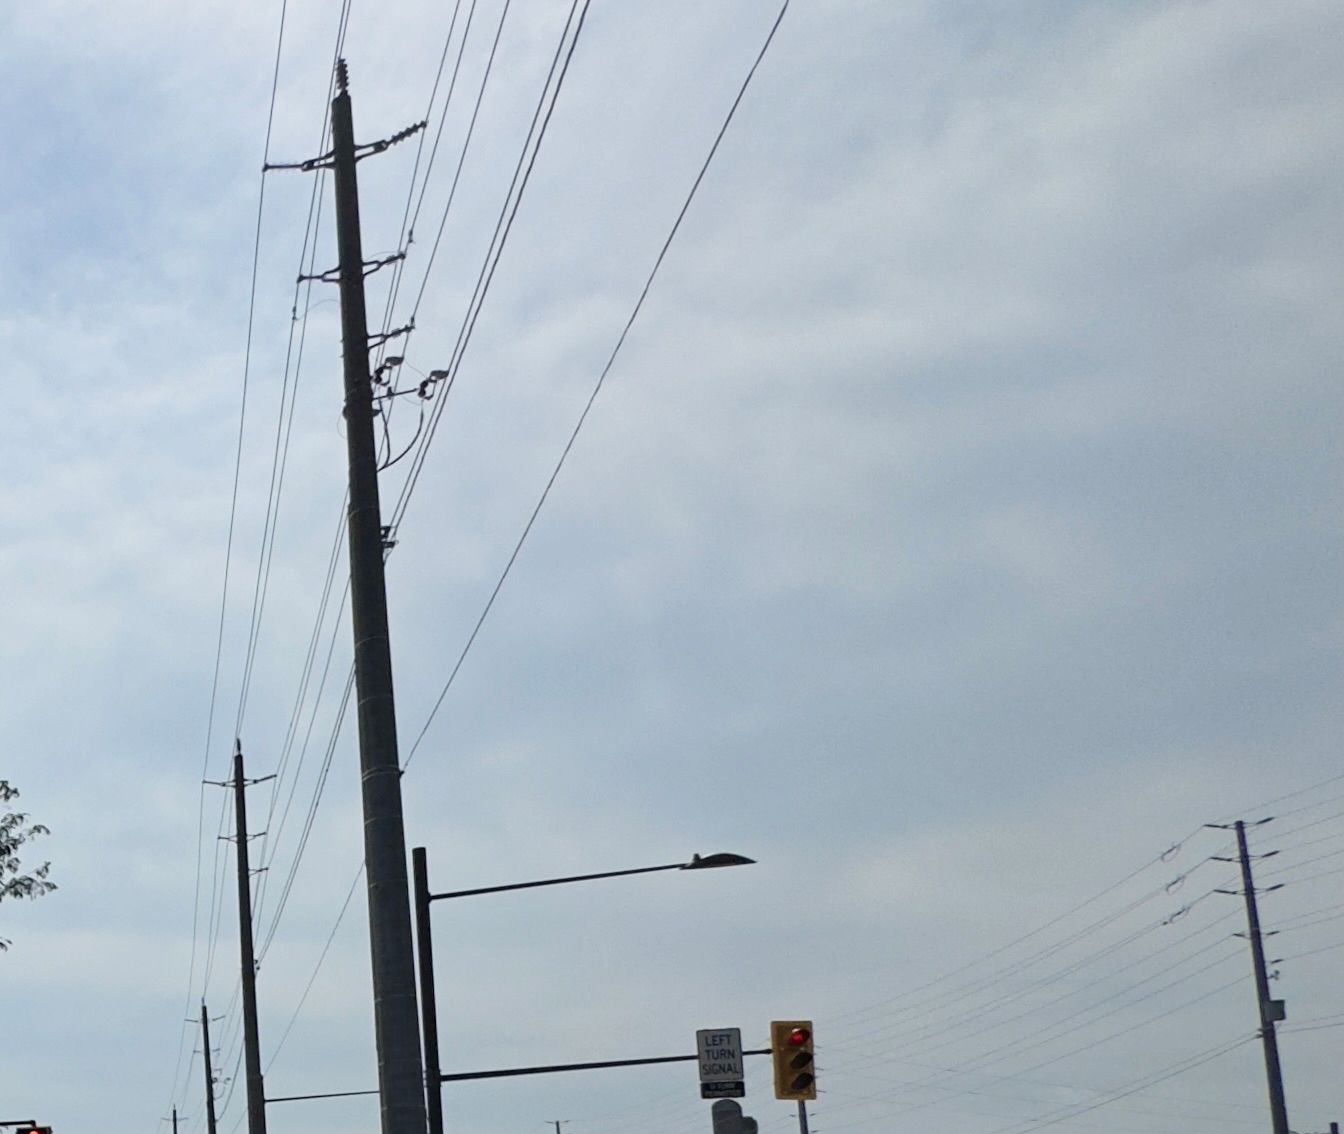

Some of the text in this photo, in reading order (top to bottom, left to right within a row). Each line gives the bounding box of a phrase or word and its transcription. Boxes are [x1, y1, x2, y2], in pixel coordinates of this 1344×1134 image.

[705, 1034, 732, 1047] LEFT
[705, 1049, 735, 1060] TURN
[702, 1063, 739, 1075] SIGNAL
